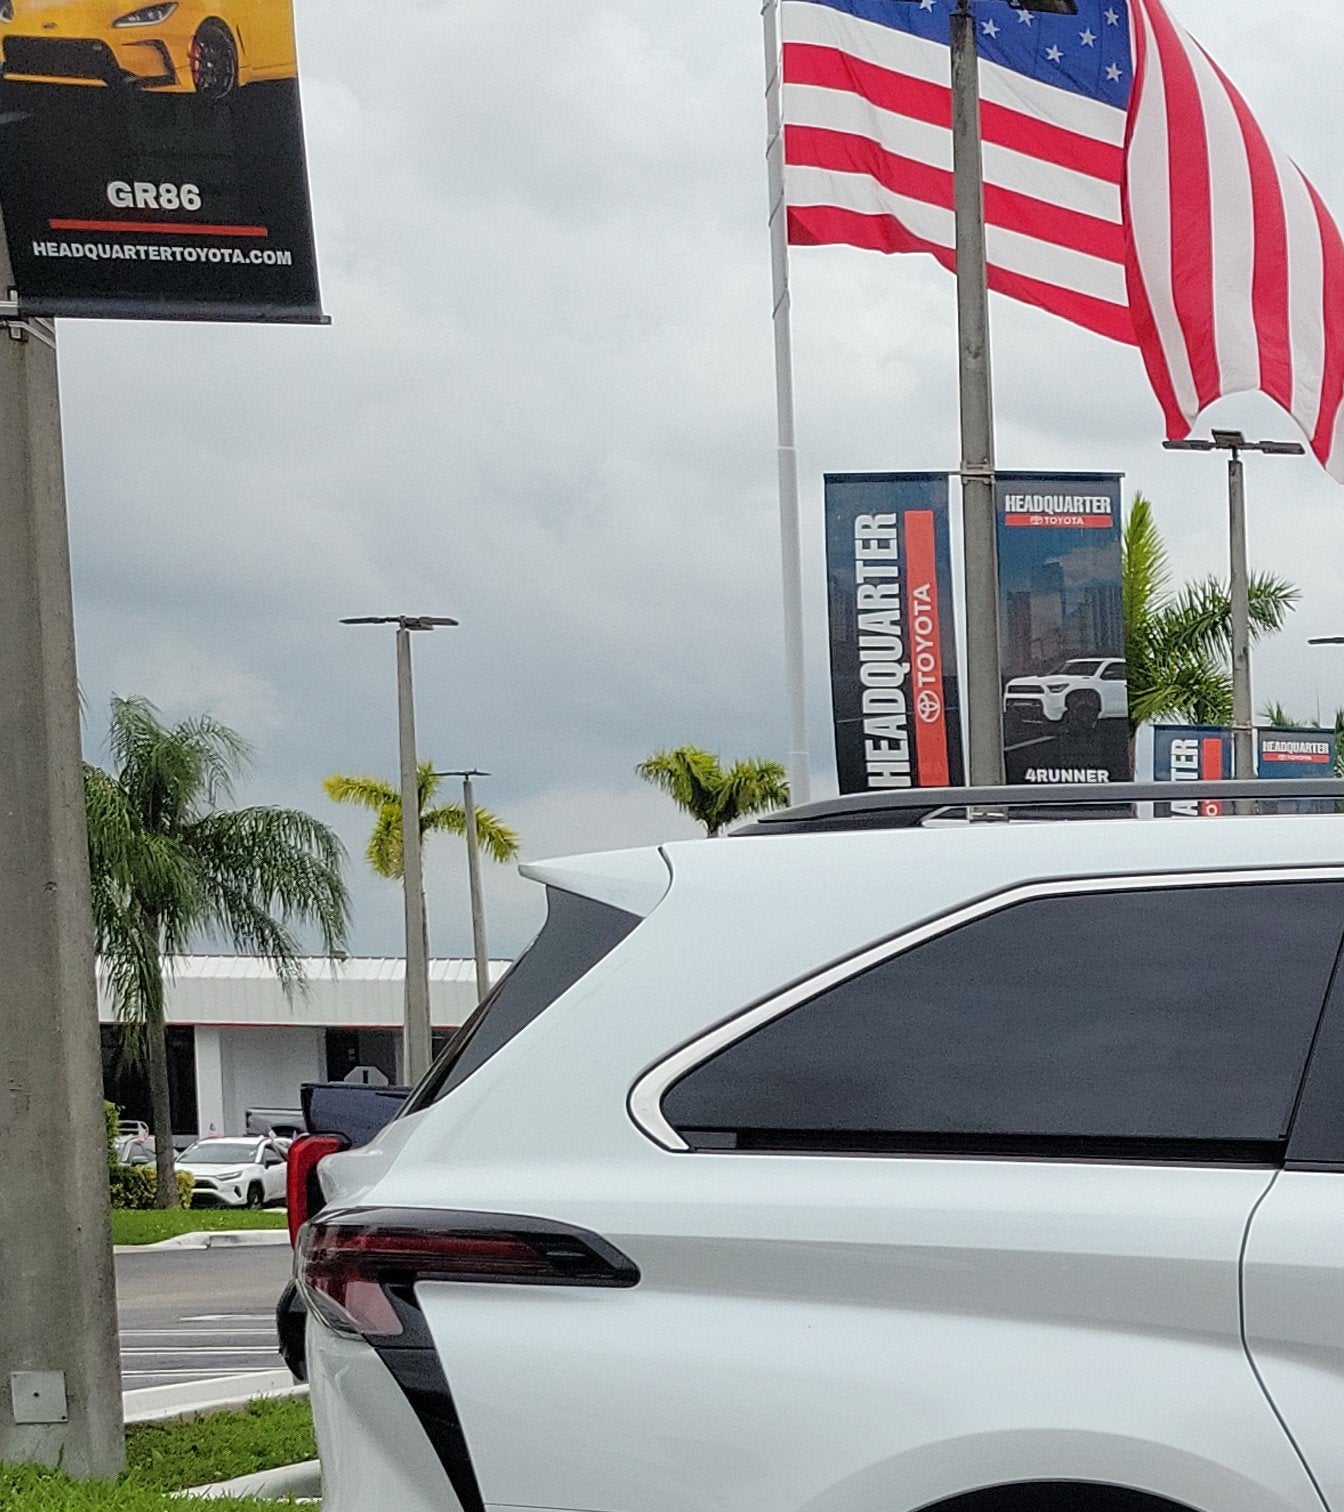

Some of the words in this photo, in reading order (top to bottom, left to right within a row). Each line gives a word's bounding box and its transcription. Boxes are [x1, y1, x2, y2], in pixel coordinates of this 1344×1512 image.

[107, 180, 202, 211] GR86
[32, 241, 292, 266] HEADQUARTERTOYOTA.COM
[1005, 494, 1112, 515] HEADQUARTER
[1045, 516, 1084, 525] TOYOTA
[914, 582, 937, 688] TOYOTA
[855, 512, 911, 787] HEADQUARTER
[1262, 741, 1329, 754] HEADQUARTER
[1025, 767, 1110, 783] 4RUNNER
